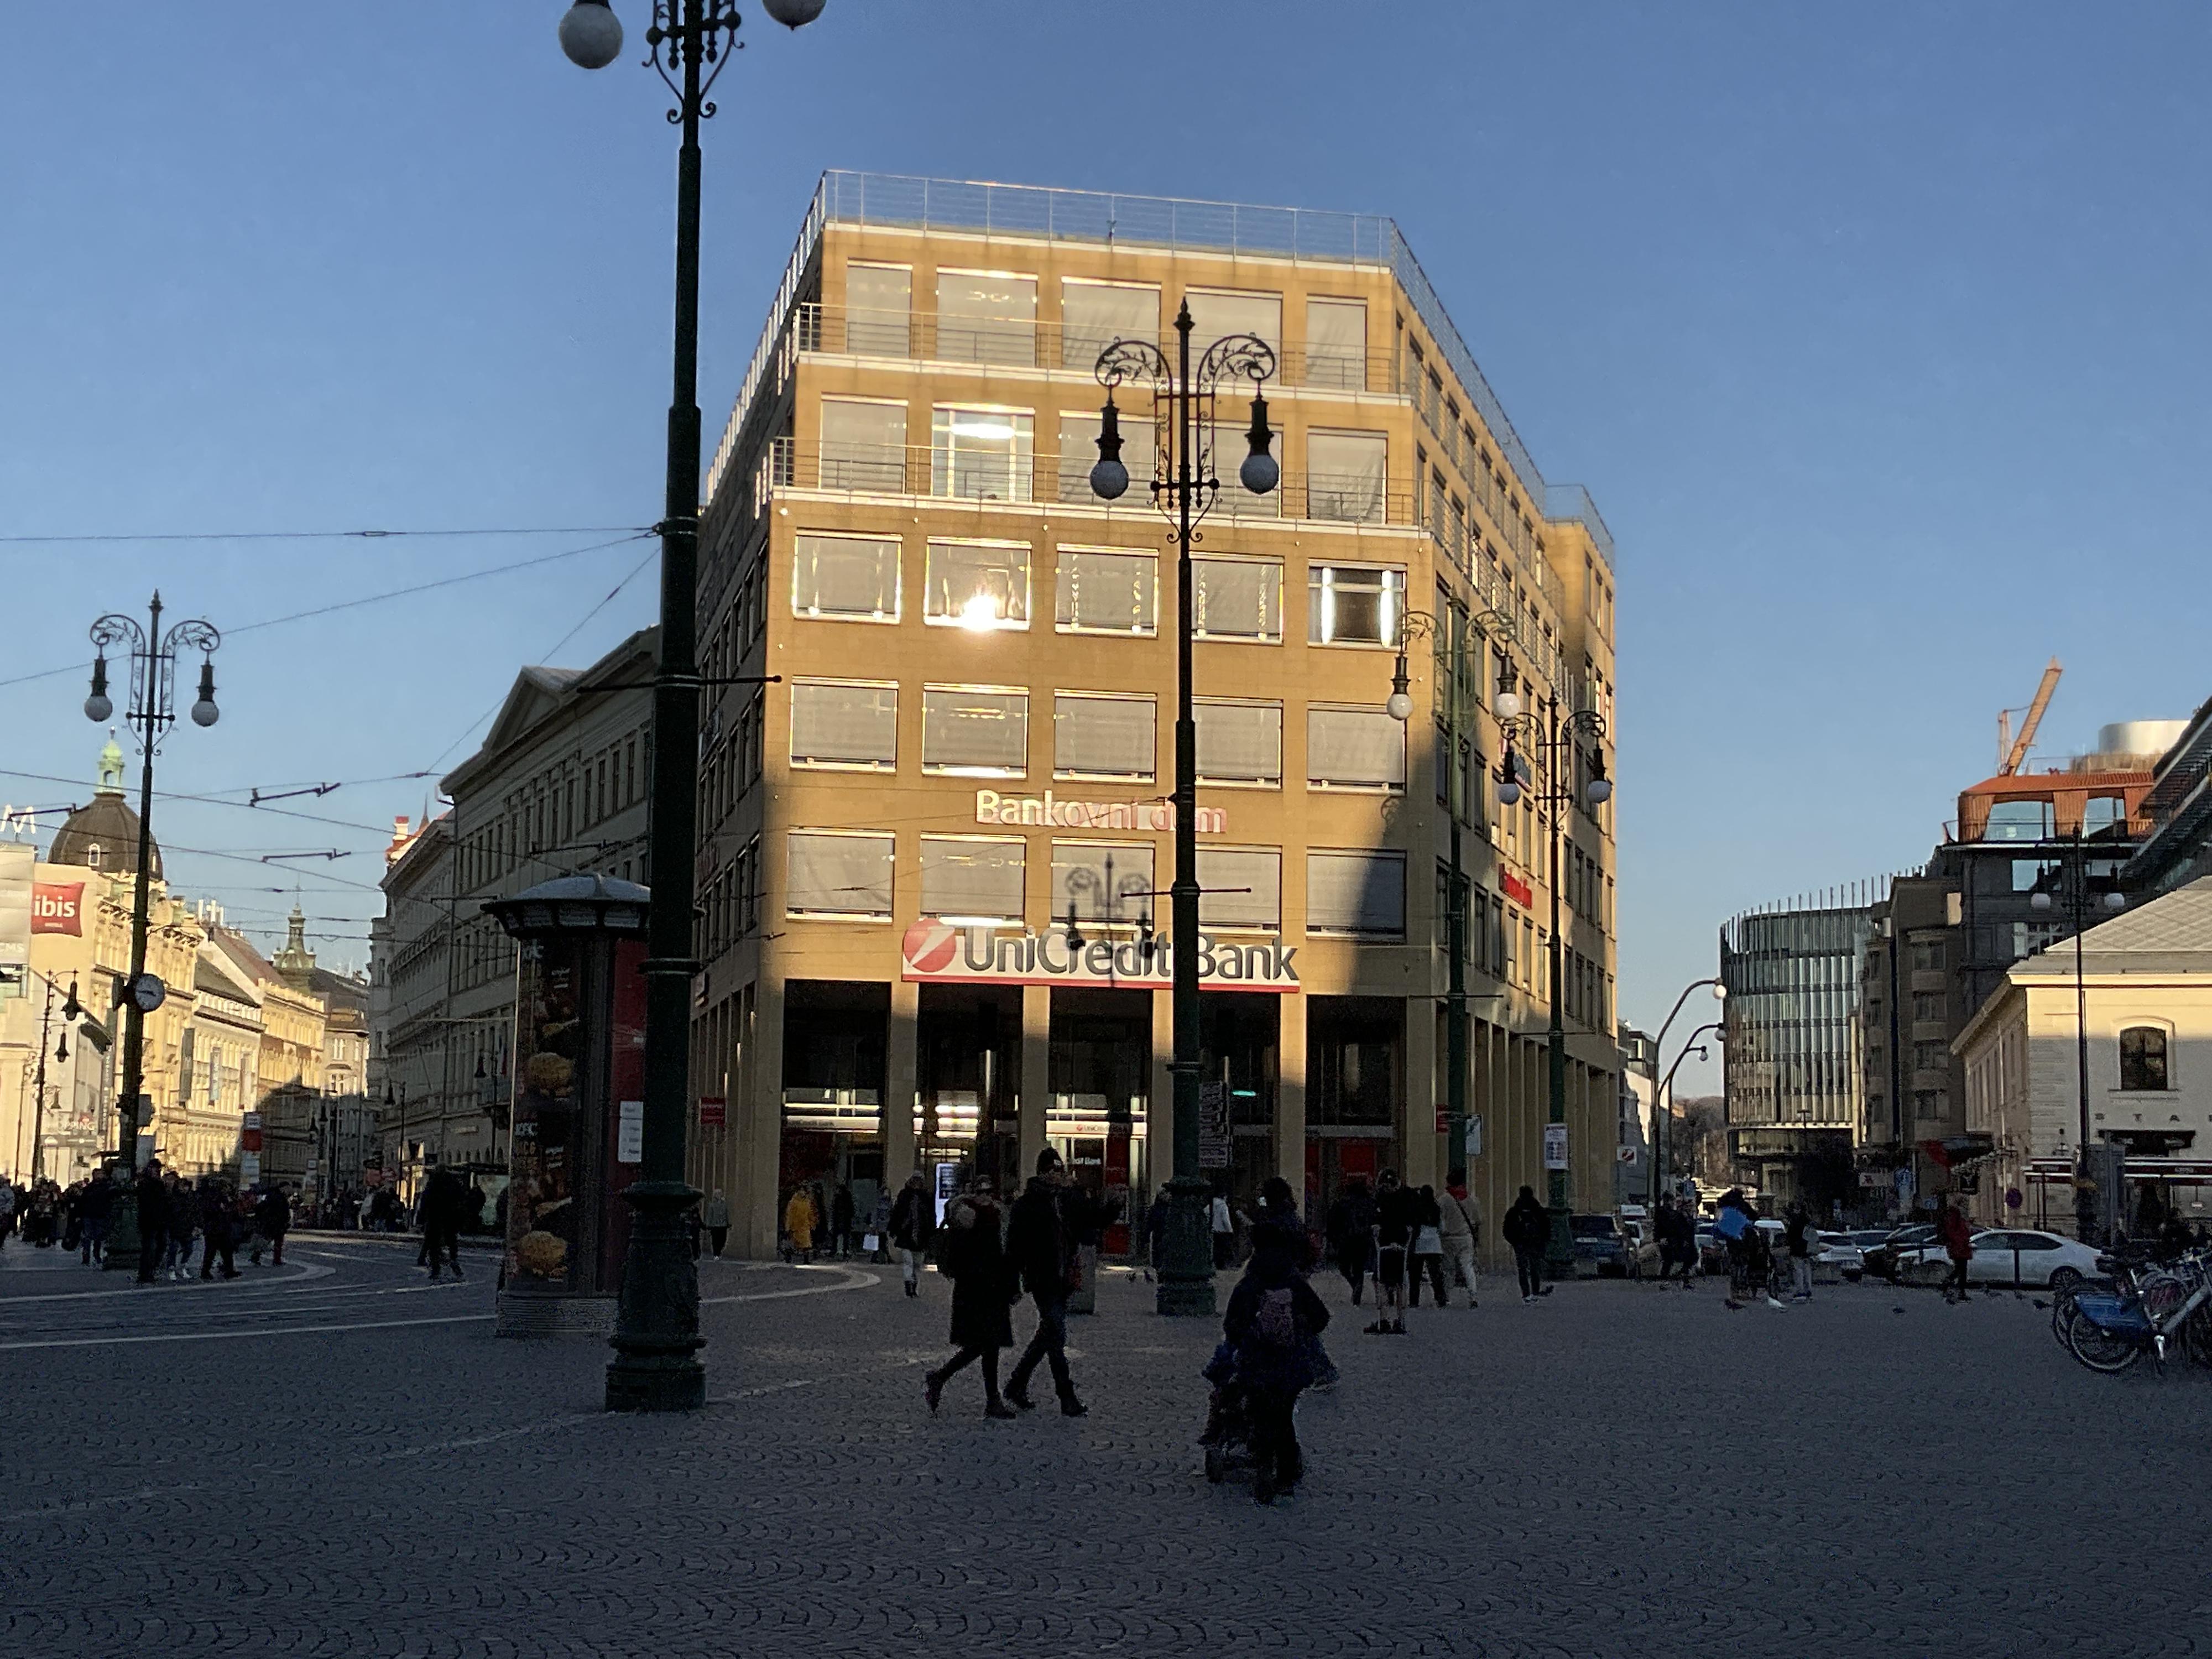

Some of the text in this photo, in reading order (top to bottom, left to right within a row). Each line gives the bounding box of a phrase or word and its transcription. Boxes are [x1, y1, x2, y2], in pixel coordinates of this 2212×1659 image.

[1151, 796, 1227, 832] dm
[34, 895, 75, 917] ibis
[964, 925, 1300, 980] UniCredit Bank
